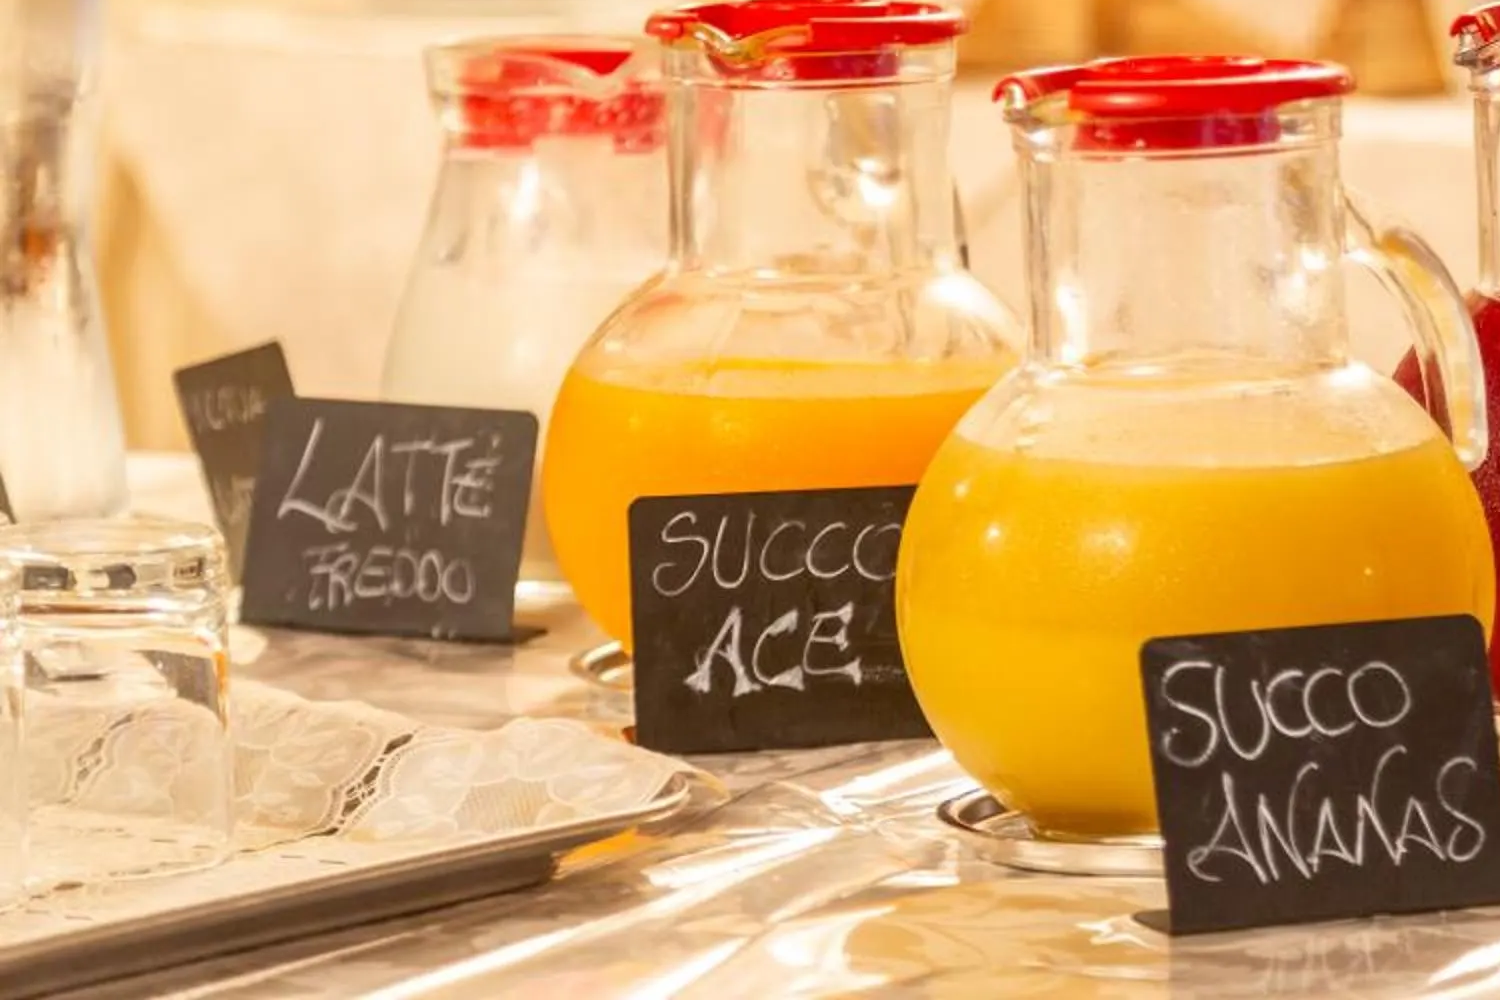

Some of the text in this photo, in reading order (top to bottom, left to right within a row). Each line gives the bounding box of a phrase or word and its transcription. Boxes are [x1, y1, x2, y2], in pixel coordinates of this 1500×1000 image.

[652, 510, 902, 597] SUCCO
[683, 600, 863, 697] ACE
[1160, 660, 1412, 767] SUCCO
[1186, 744, 1486, 884] ANANAS
